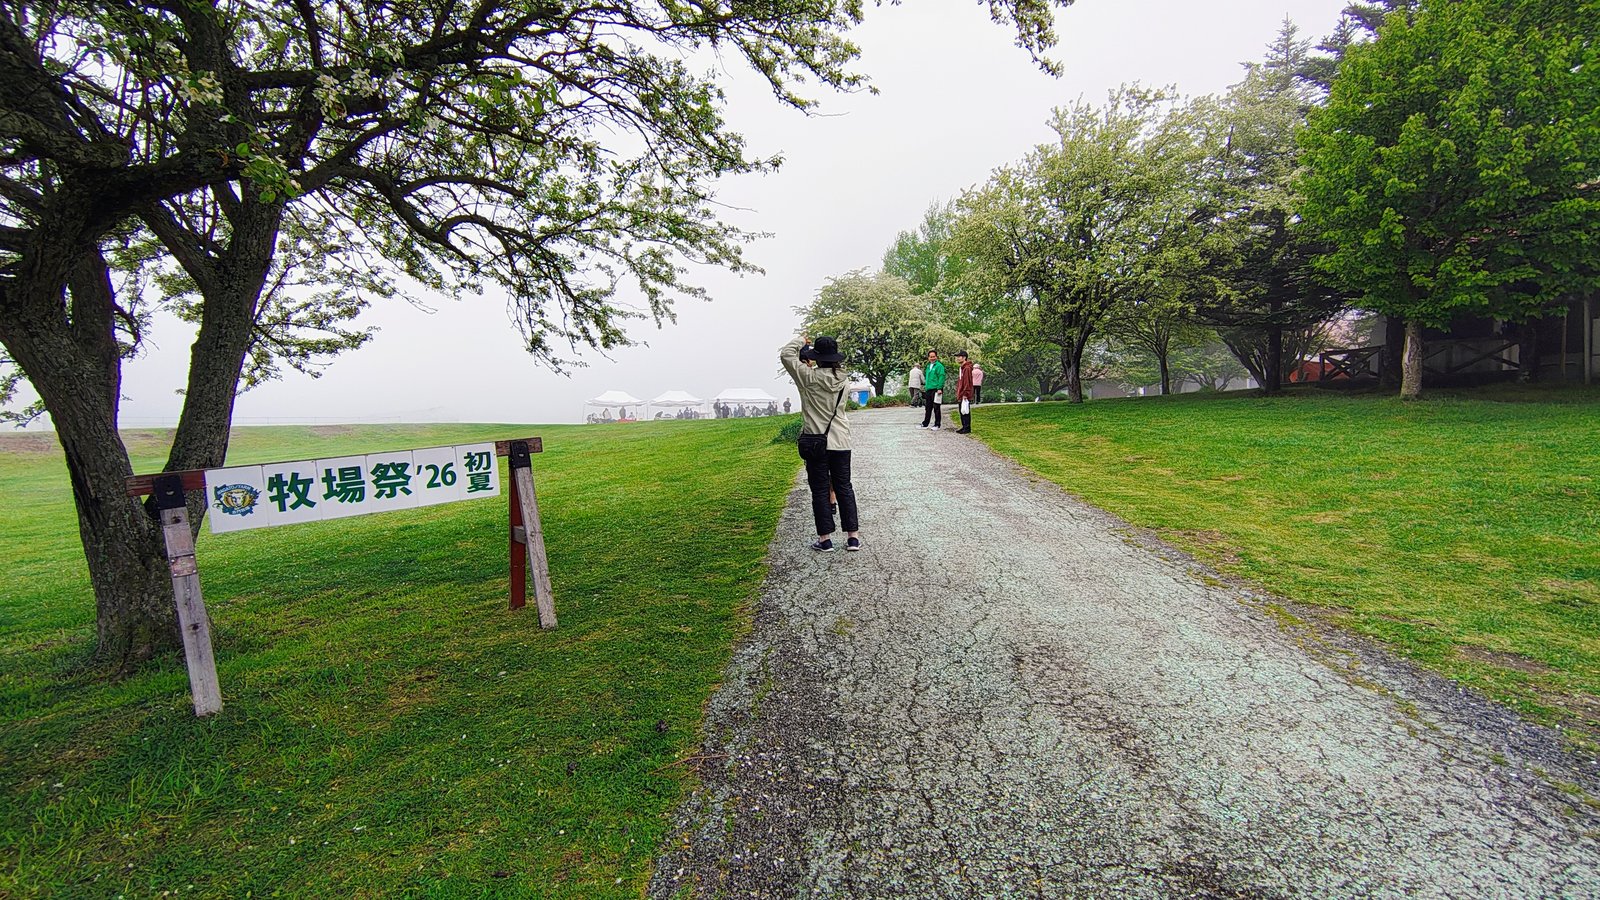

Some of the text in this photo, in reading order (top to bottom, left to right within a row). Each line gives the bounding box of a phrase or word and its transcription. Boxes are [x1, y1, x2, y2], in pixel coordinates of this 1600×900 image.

[267, 462, 413, 512] 牧場祭
[464, 452, 495, 494] 初夏
